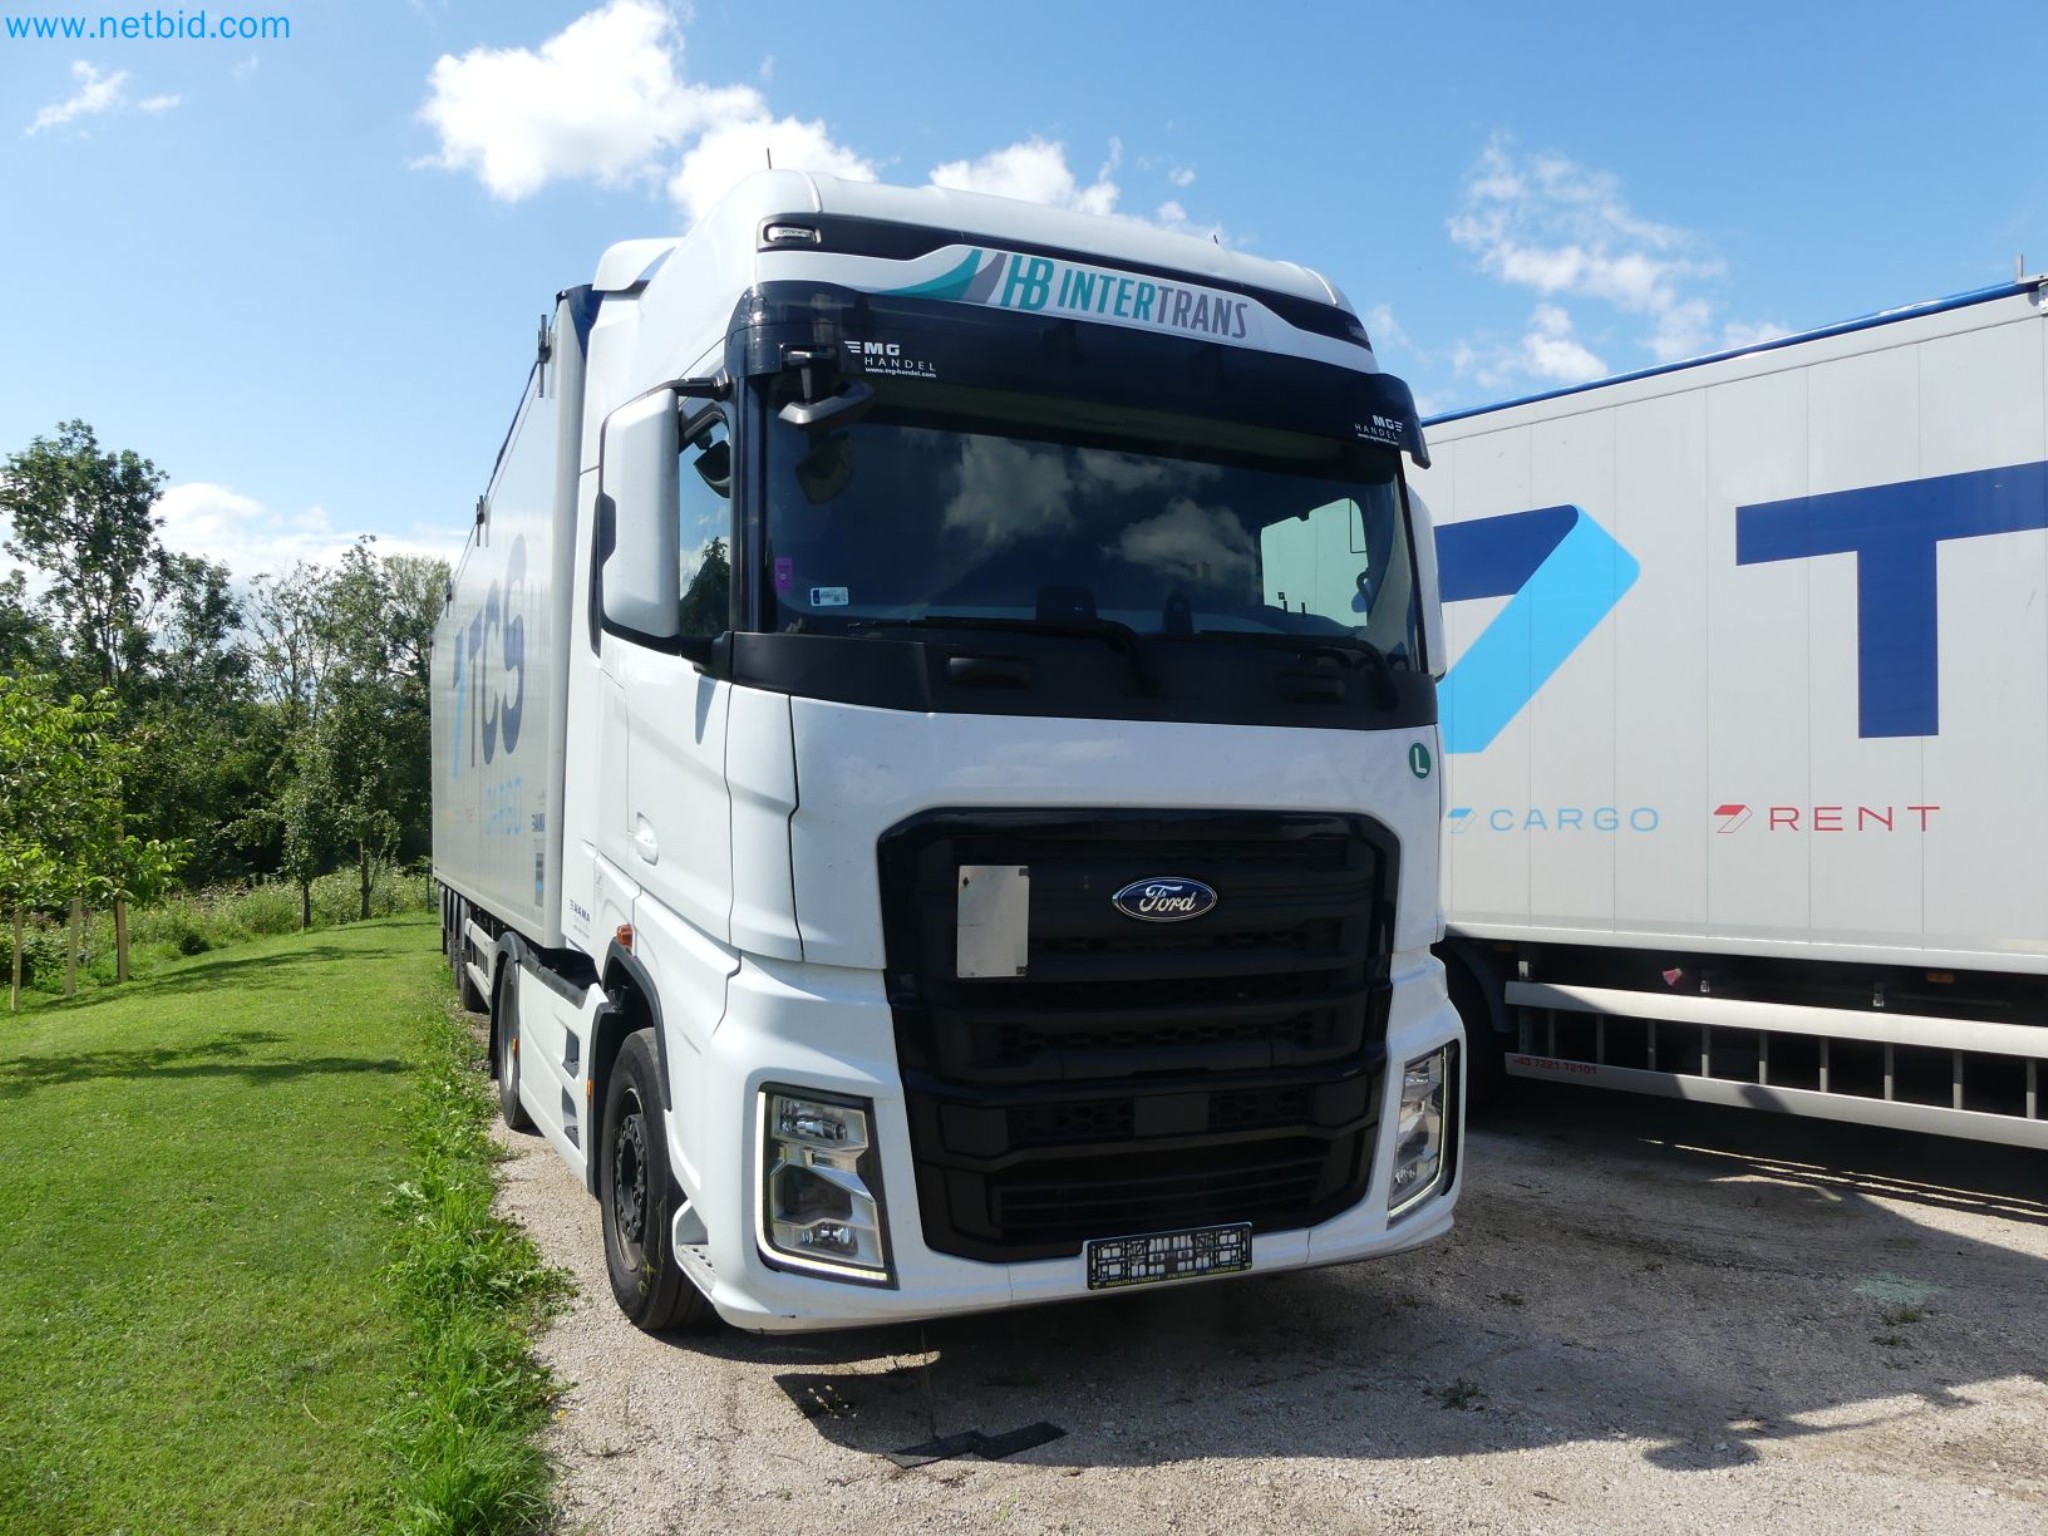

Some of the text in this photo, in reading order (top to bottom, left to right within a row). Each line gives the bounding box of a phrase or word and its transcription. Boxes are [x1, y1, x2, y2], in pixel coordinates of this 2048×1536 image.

[999, 253, 1249, 340] HB INTERTRANS
[863, 341, 900, 356] MG
[863, 356, 937, 372] HANDEL
[1354, 423, 1398, 440] HANDEL
[1371, 414, 1396, 430] MG
[1489, 806, 1660, 832] CARGO
[1769, 805, 1941, 832] RENT
[1138, 884, 1198, 912] Ford
